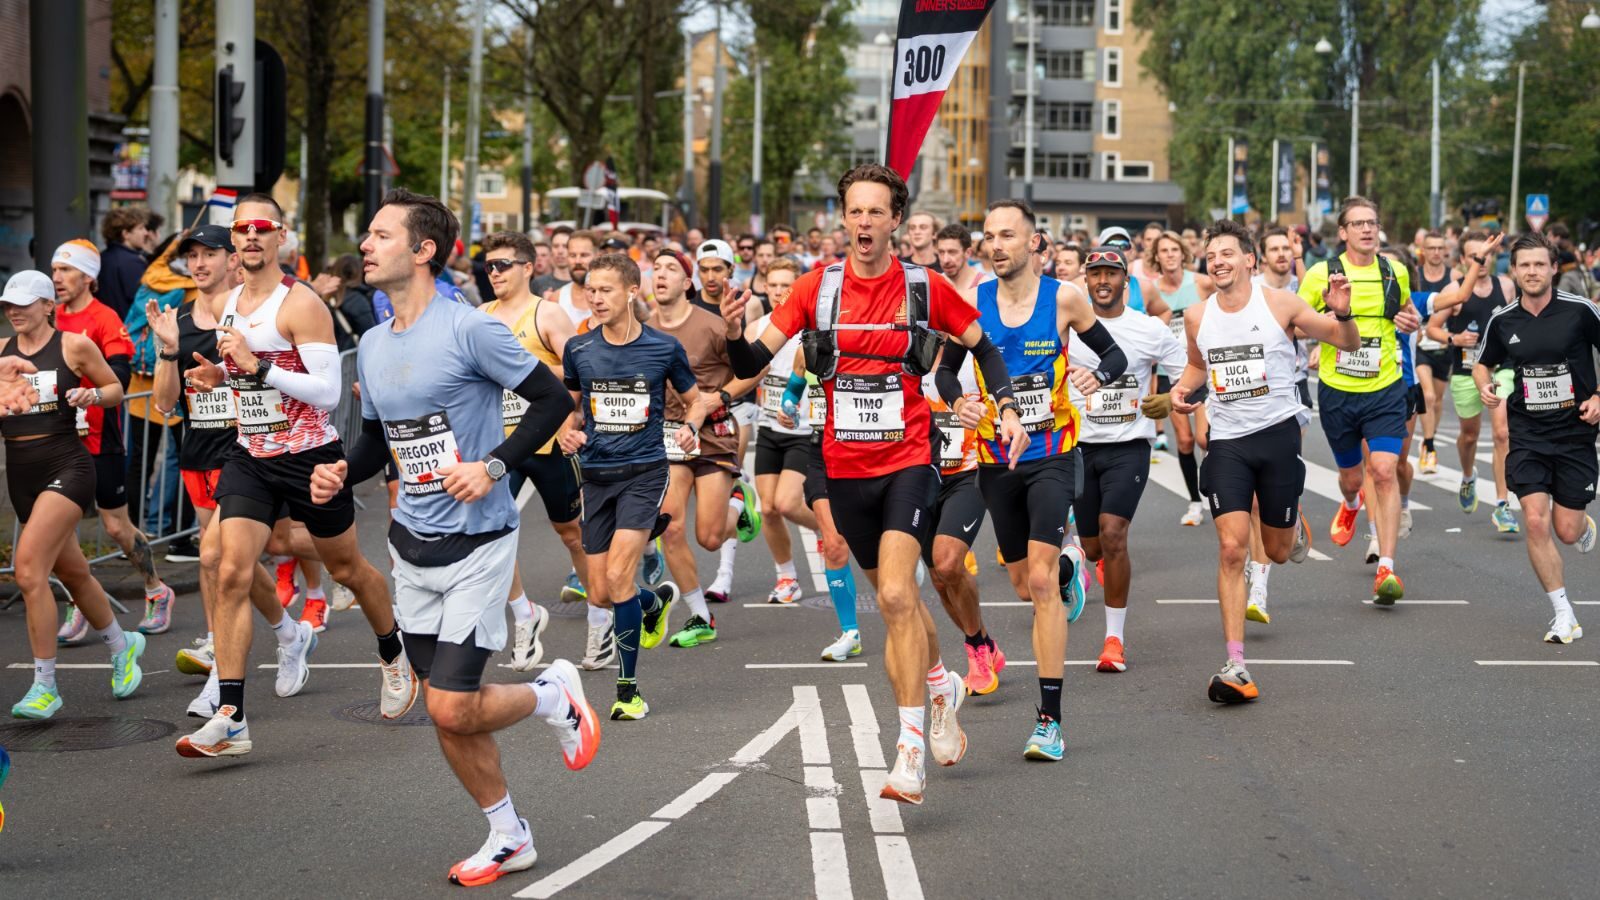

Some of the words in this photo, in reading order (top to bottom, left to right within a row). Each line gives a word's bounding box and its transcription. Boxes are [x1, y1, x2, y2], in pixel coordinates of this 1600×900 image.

[904, 44, 946, 87] 300
[1024, 340, 1055, 348] VIGILANTE
[1210, 353, 1224, 362] tcs
[1225, 365, 1248, 376] LUCA
[592, 381, 608, 392] tcs
[836, 377, 853, 390] tcs
[1225, 376, 1251, 387] 21614
[1536, 380, 1558, 390] DIRK
[196, 391, 228, 404] ARTUR
[502, 392, 518, 402] IAS
[1102, 392, 1124, 402] OLAF
[1252, 387, 1269, 397] 2025
[1538, 390, 1558, 399] 3614
[241, 393, 264, 406] BLAŽ
[604, 397, 636, 408] GUIDO
[853, 398, 883, 410] TIMO
[41, 402, 58, 413] 2025
[199, 404, 227, 415] 21183
[1102, 402, 1122, 411] 9501
[241, 408, 269, 418] 21496
[610, 409, 628, 418] 514
[858, 412, 879, 423] 178
[190, 420, 224, 429] AMSTERDAM
[240, 425, 270, 434] STERDAM
[270, 422, 288, 432] 2025
[594, 424, 630, 432] AMSTERDAM
[1038, 420, 1055, 430] 2025
[387, 424, 400, 439] tcs
[429, 424, 448, 433] TATA
[836, 431, 882, 441] AMSTERDAM
[884, 431, 904, 441] 2025
[396, 440, 446, 460] GREGORY
[407, 458, 440, 475] 20712
[404, 481, 443, 494] AMSTERDAM
[912, 508, 921, 528] FUSION
